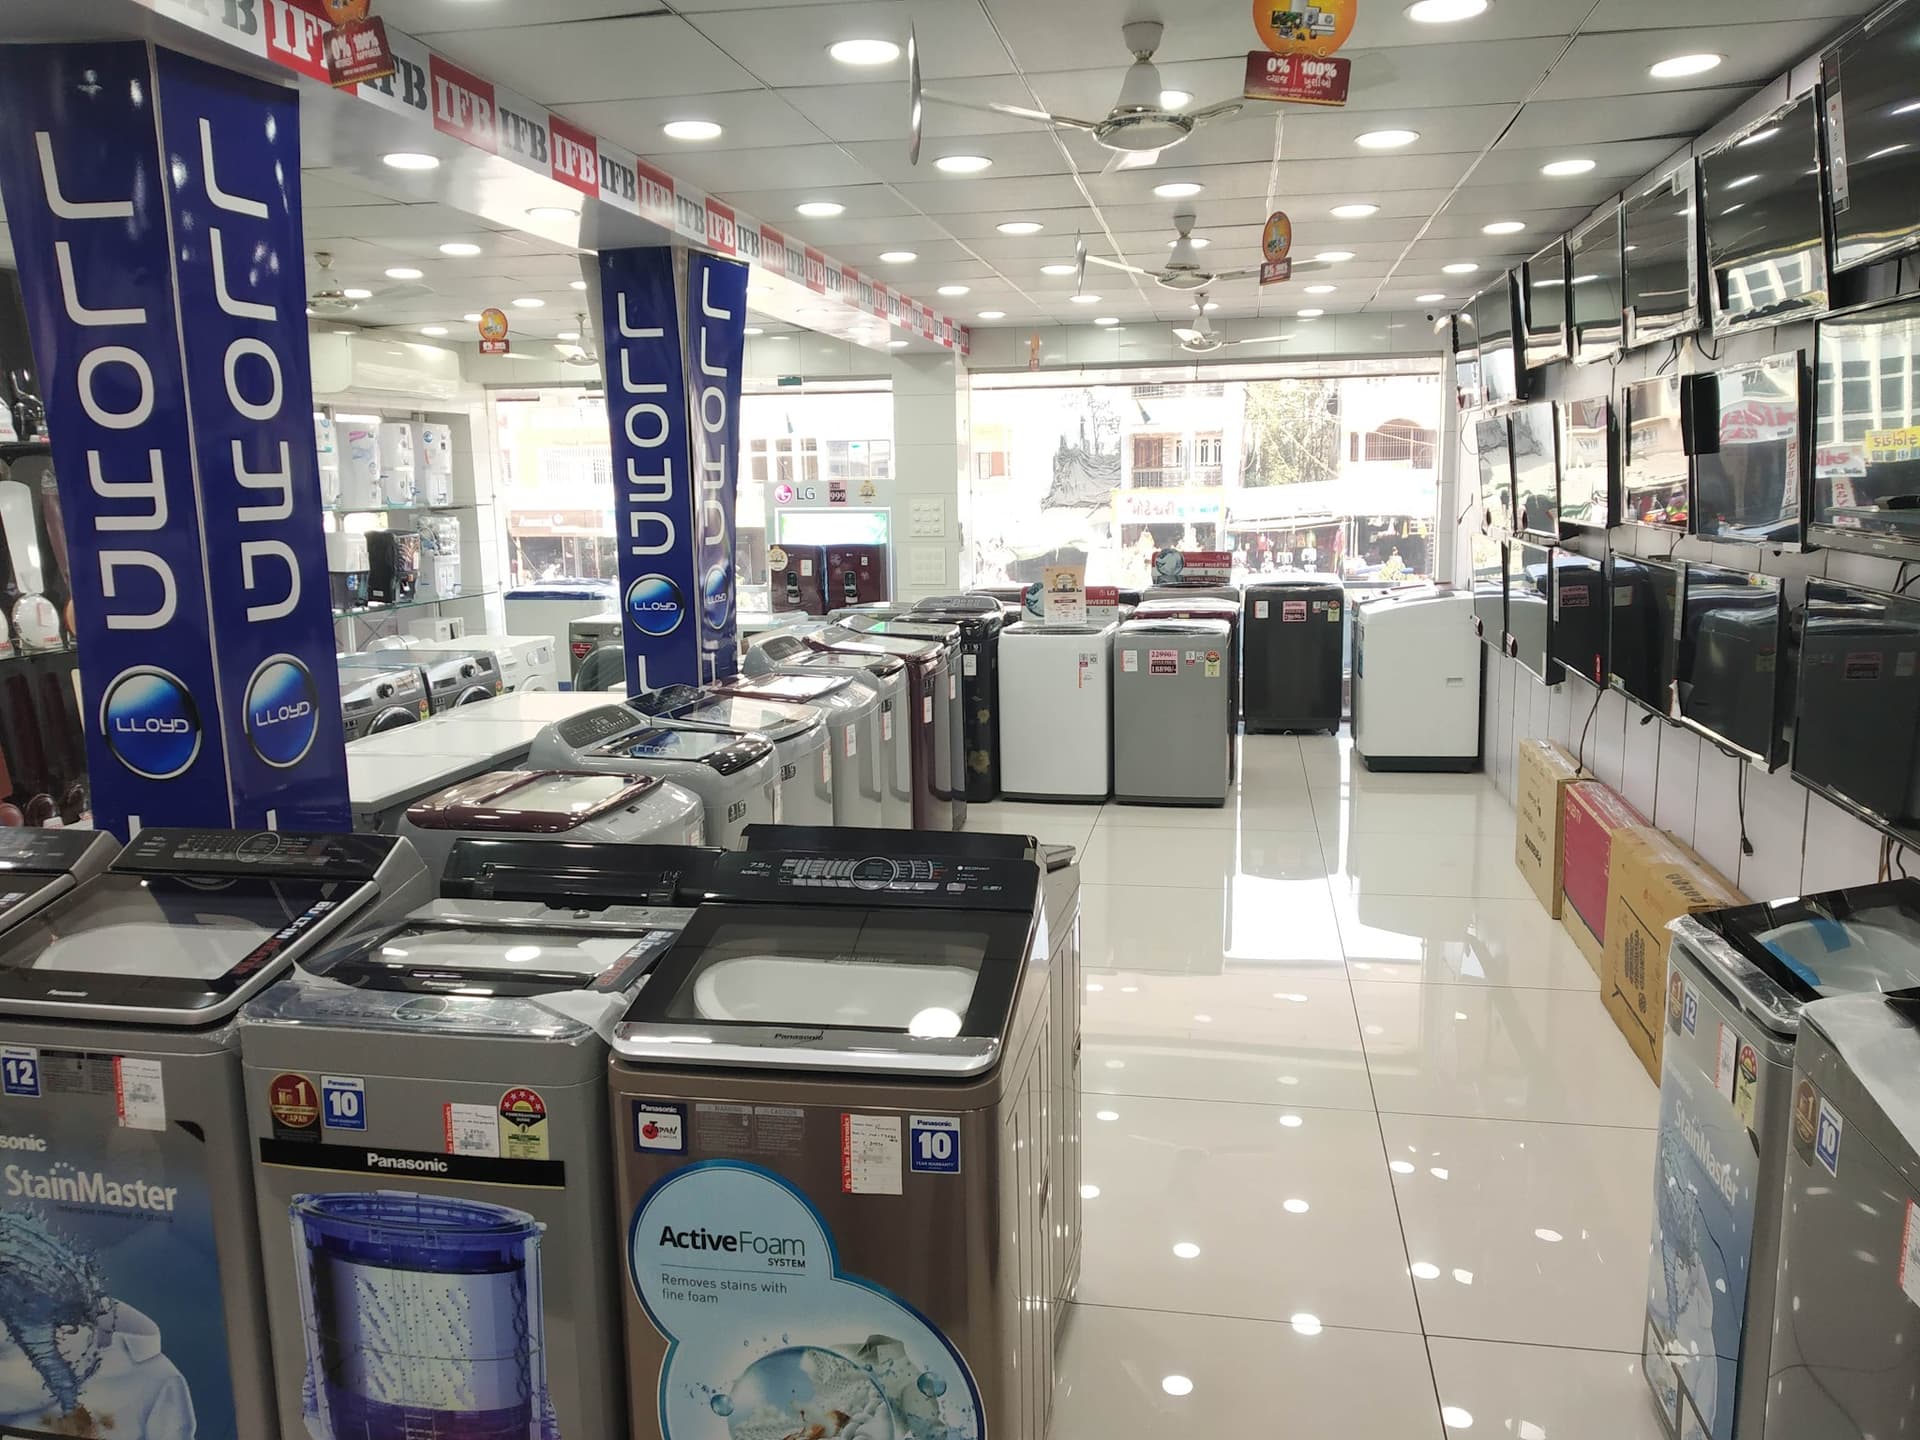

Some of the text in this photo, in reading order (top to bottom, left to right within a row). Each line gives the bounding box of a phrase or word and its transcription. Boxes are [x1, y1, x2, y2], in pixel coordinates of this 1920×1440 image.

[1267, 58, 1290, 74] 0%
[1300, 61, 1338, 78] 100%
[435, 75, 494, 138] IFB
[498, 106, 548, 164] IFB
[552, 132, 596, 185] IFB
[599, 154, 636, 202] IFB
[639, 175, 674, 214] IFB
[676, 194, 705, 236] IFB
[707, 210, 735, 248] IFB
[737, 224, 760, 258] IFB
[761, 235, 785, 268] IFB
[785, 248, 805, 277] IFB
[806, 258, 824, 286] IFB
[825, 266, 841, 292] IFB
[873, 288, 887, 312] IFB
[35, 131, 179, 631] LLOYD
[199, 117, 302, 625] LLOYD
[700, 265, 731, 547] LLOYD
[616, 292, 677, 556] LLOYD
[796, 487, 816, 500] LG
[830, 491, 846, 501] 999
[633, 600, 678, 612] LLOYD
[707, 589, 728, 607] LLOYD
[115, 716, 190, 734] LLOYD
[254, 700, 311, 729] LLOYD
[1685, 994, 1697, 1025] 12
[6, 1060, 35, 1086] 12
[329, 1090, 359, 1118] 10
[640, 1103, 678, 1113] Panasonic
[917, 1119, 953, 1127] Panasonic
[1822, 1119, 1836, 1155] 10
[918, 1131, 952, 1160] 10
[1673, 1100, 1740, 1207] StainMaster
[366, 1152, 449, 1173] Panasonic
[4, 1161, 178, 1212] StainMaster
[659, 1226, 806, 1257] ActiveFoam
[767, 1257, 806, 1269] SYSTEM
[661, 1272, 788, 1295] Removes stains with
[661, 1288, 719, 1304] fine foam
